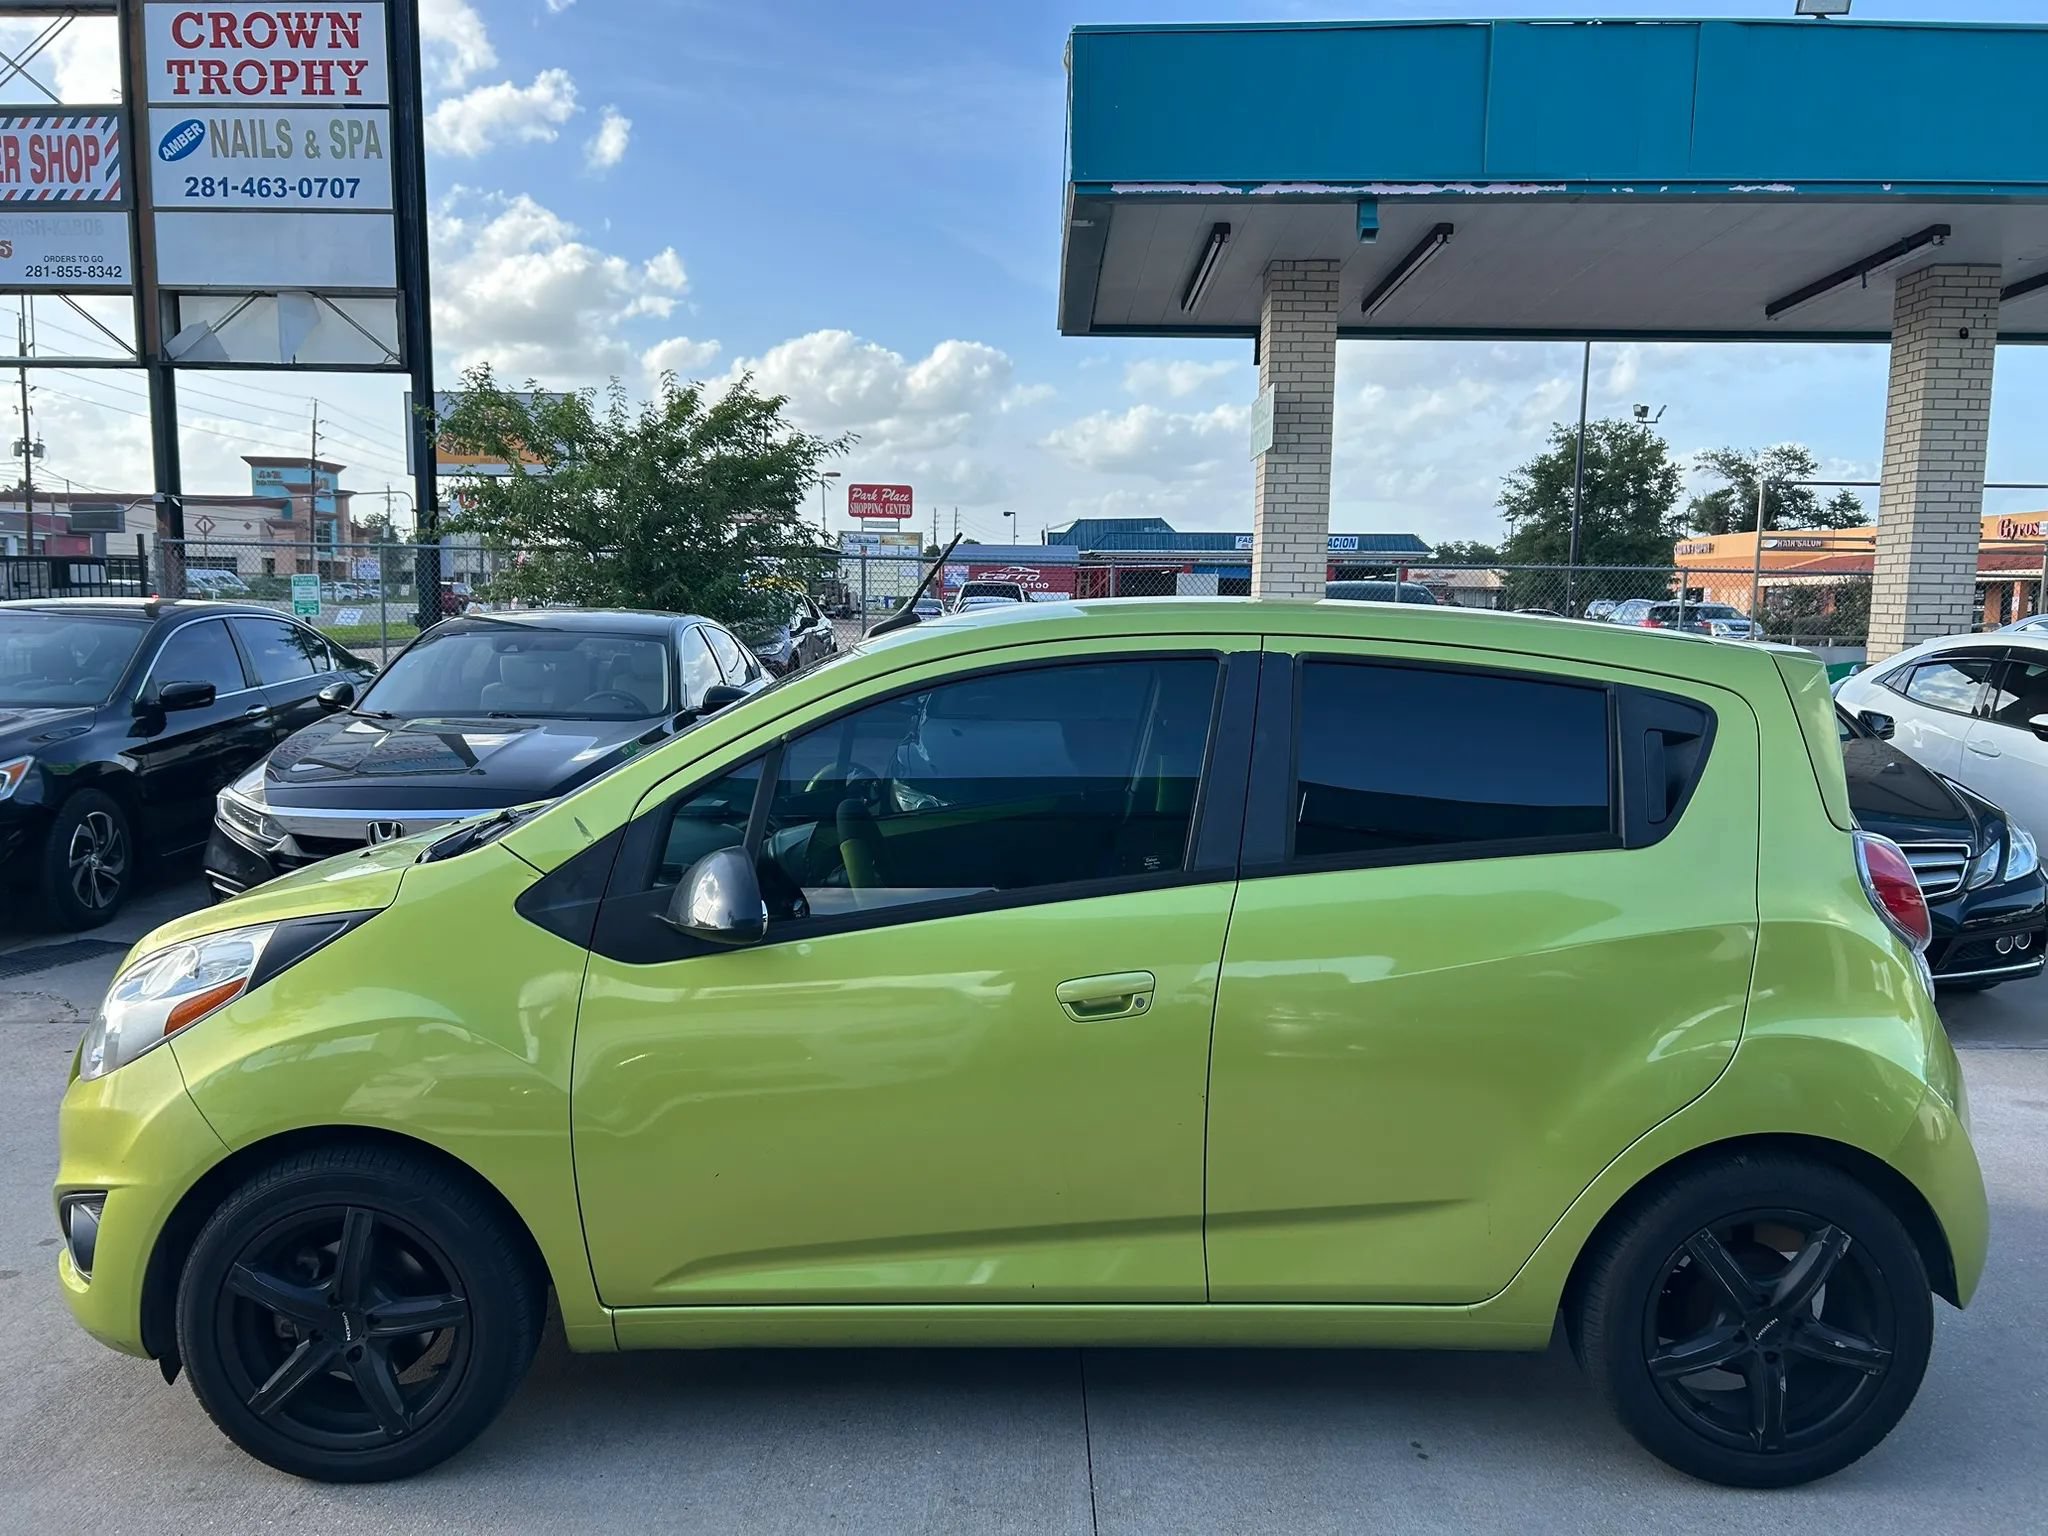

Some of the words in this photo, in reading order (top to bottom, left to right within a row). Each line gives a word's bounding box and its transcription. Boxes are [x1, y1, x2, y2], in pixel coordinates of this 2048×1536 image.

[171, 11, 362, 49] CROWN
[166, 59, 368, 96] TROPHY
[161, 121, 204, 160] AMBER
[209, 118, 293, 159] NAILS
[304, 129, 321, 159] &
[329, 118, 383, 160] SPA
[29, 134, 100, 184] SHOP
[184, 176, 361, 198] 281-463-0707
[43, 255, 77, 263] ORDERS
[79, 255, 90, 263] TO
[91, 255, 104, 263] GO
[25, 265, 122, 278] 281-855-8342
[852, 487, 879, 501] Park
[880, 488, 910, 502] Place
[849, 502, 883, 515] SHOPPING
[885, 503, 911, 516] CENTER
